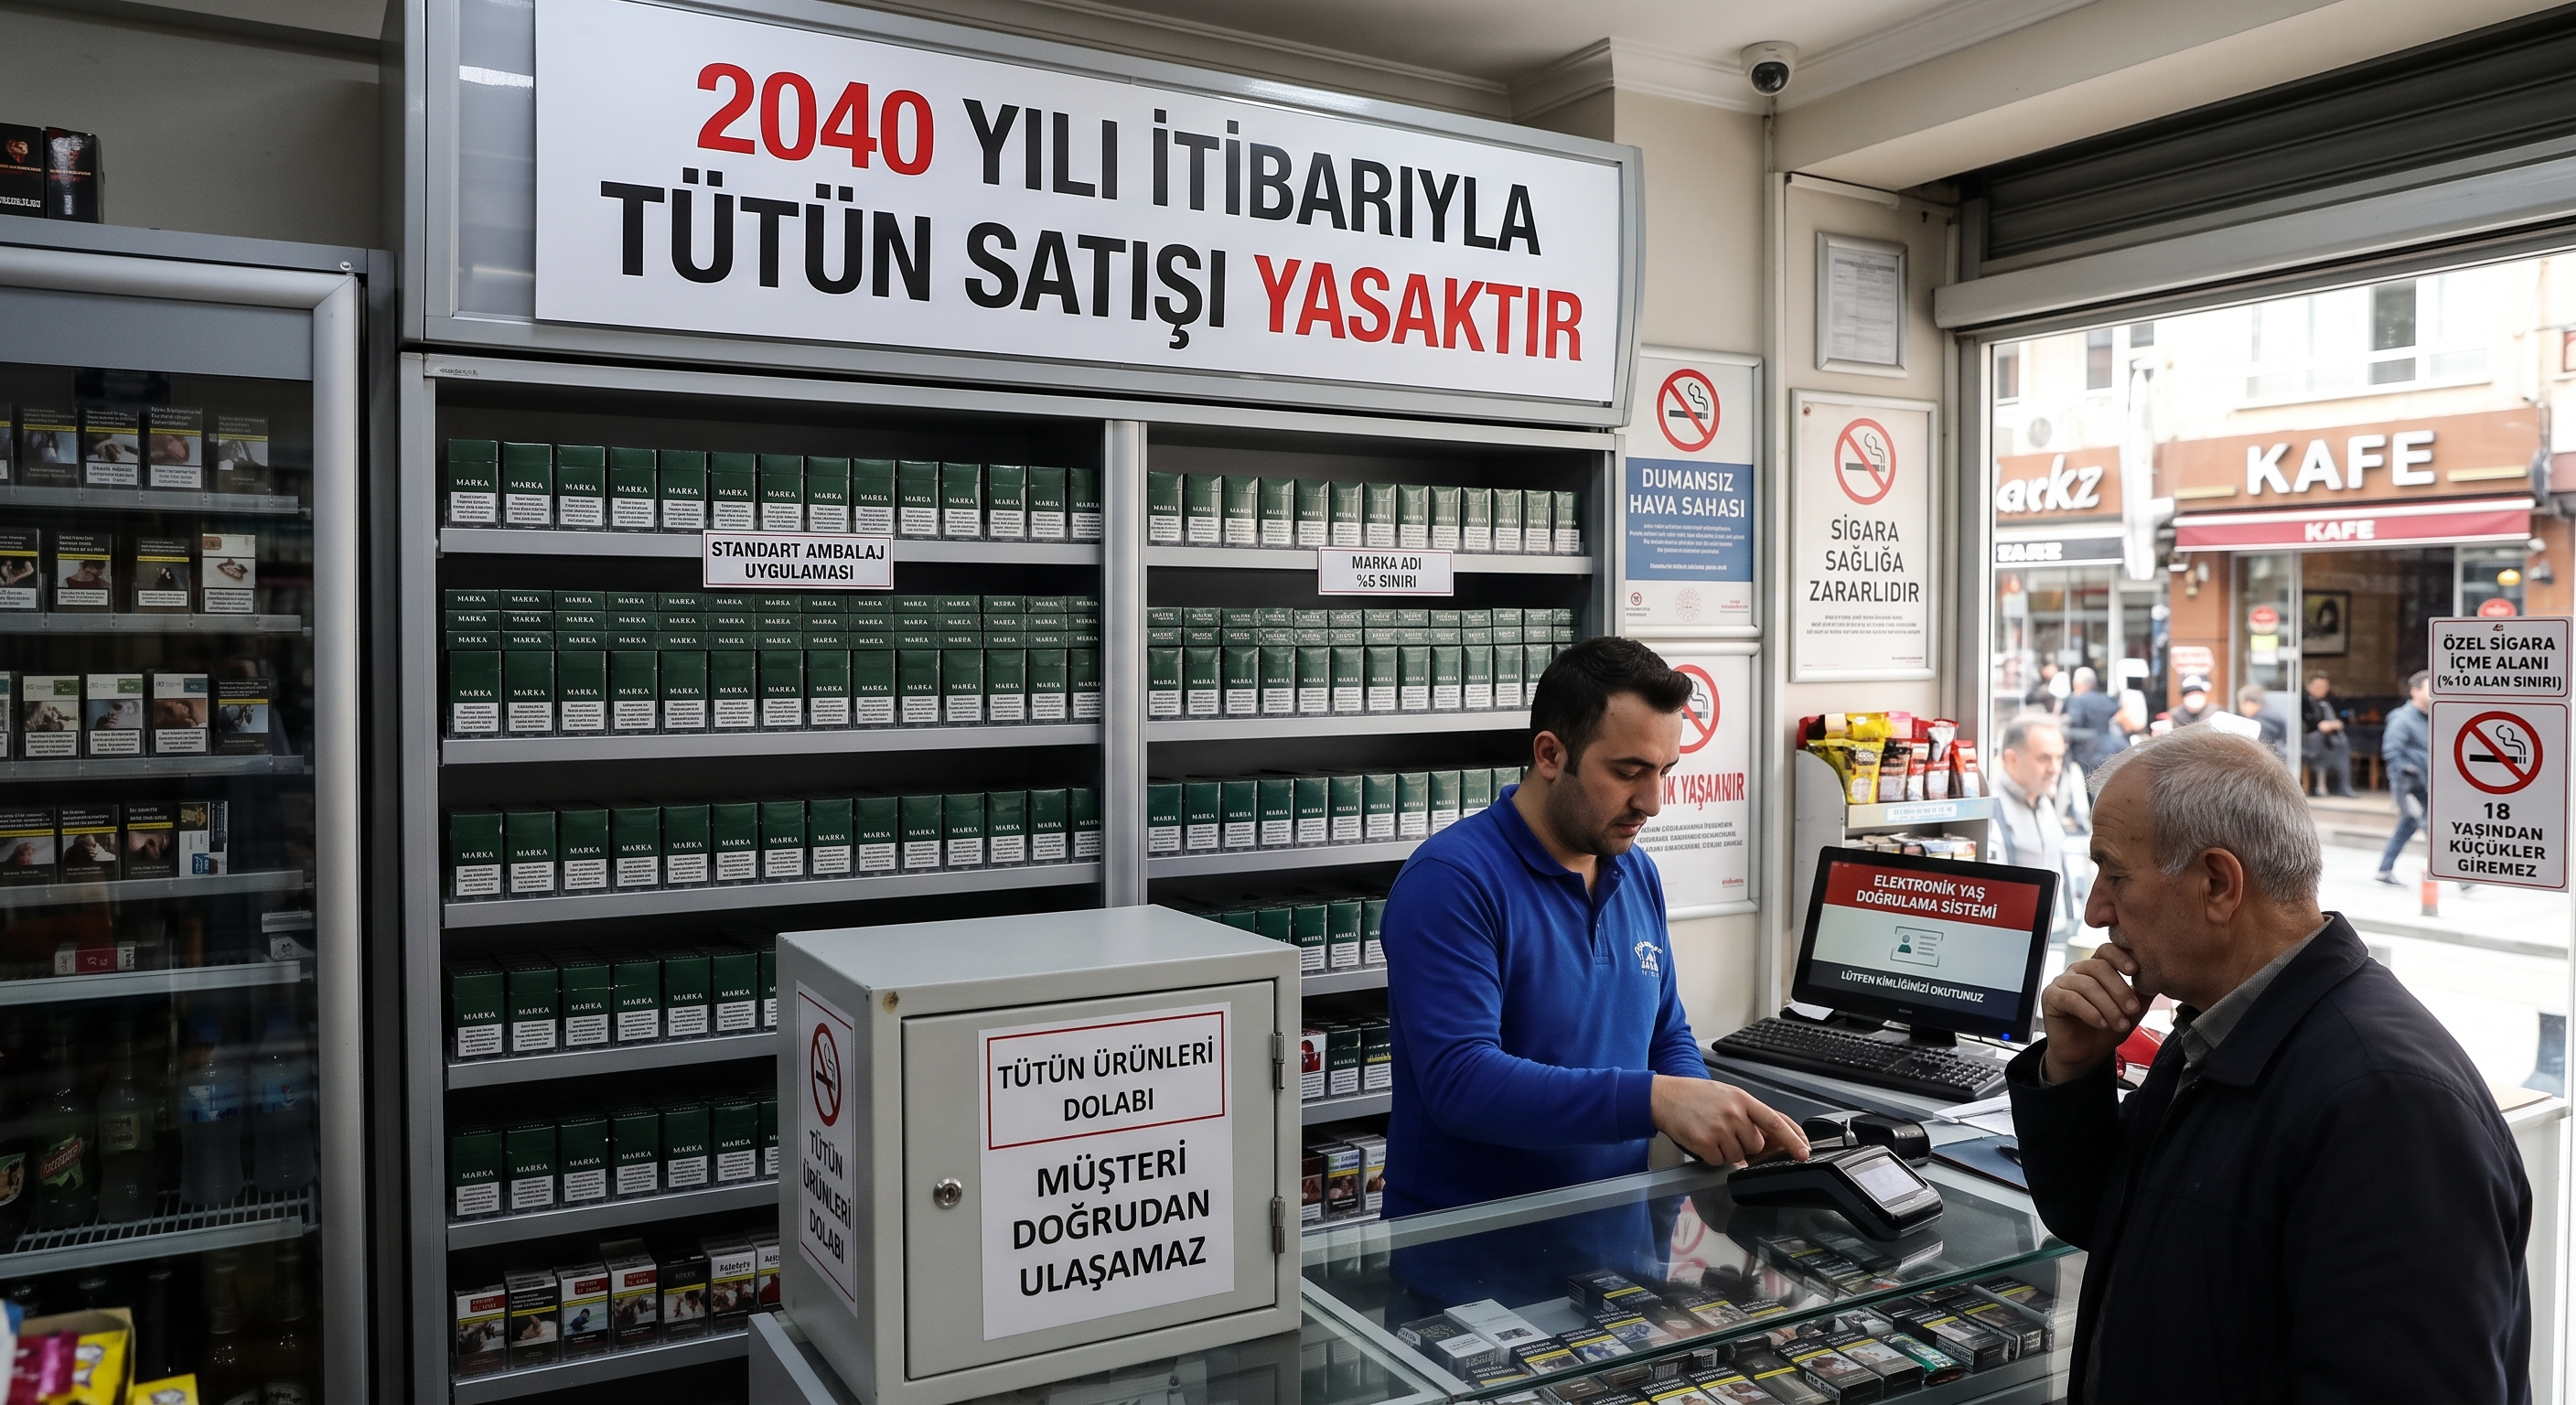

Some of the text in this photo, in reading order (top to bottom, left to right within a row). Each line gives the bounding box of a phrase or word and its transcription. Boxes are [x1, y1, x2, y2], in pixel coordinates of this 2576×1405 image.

[697, 62, 1541, 256] 2040 YILI İTİBARIYLA
[600, 166, 1583, 361] TÜTÜN SATIŞI YASAKTIR
[2247, 430, 2435, 495] KAFE
[511, 481, 543, 489] MARKA
[565, 483, 596, 491] MARKA
[617, 486, 648, 494] MARKA
[1642, 468, 1733, 492] DUMANSIZ
[719, 488, 747, 497] MARKA
[1629, 494, 1745, 518] HAVA SAHASI
[1830, 513, 1899, 542] SİGARA
[2304, 520, 2376, 541] KAFE
[712, 542, 886, 561] STANDART AMBALAJ
[1824, 545, 1905, 573] SAĞLIĞA
[745, 563, 854, 581] UYGULAMASI
[1352, 556, 1422, 571] MARKA ADI
[1357, 574, 1417, 588] %5 SINIRI
[1809, 580, 1919, 603] ZARARLIDIR
[2442, 633, 2556, 651] ÖZEL SİGARA
[2450, 653, 2549, 674] İÇME ALANI
[2437, 674, 2562, 691] (%10 ALAN SINIRI)
[2484, 802, 2510, 820] 18
[2452, 821, 2543, 841] YAŞINDAN
[2449, 838, 2546, 860] KÜÇÜKLER
[2457, 858, 2537, 878] GİREMEZ
[1873, 874, 1986, 903] ELEKTRONİK YAŞ
[1856, 889, 1998, 919] DOĞRULAMA SİSTEMİ
[674, 992, 703, 1001] MARKA
[722, 988, 750, 997] MARKA
[1841, 971, 1984, 1003] LÜTFEN KİMLİĞİNİZİ OKUTUNUZ
[519, 1006, 550, 1015] MARKA
[572, 1002, 602, 1011] MARKA
[623, 997, 652, 1006] MARKA
[464, 1012, 496, 1020] MARKA
[997, 1035, 1215, 1090] TÜTÜN ÜRÜNLERİ
[1063, 1087, 1154, 1122] DOLABI
[622, 1150, 651, 1160] MARKA
[673, 1144, 703, 1153] MARKA
[809, 1129, 843, 1180] TÜTÜN
[570, 1157, 600, 1166] MARKA
[1036, 1139, 1186, 1195] MÜŞTERİ
[463, 1169, 493, 1179] MARKA
[803, 1158, 852, 1230] ÜRÜNLERİ
[1012, 1188, 1210, 1249] DOĞRUDAN
[809, 1208, 844, 1265] DOLABI
[1020, 1236, 1207, 1297] ULAŞAMAZ
